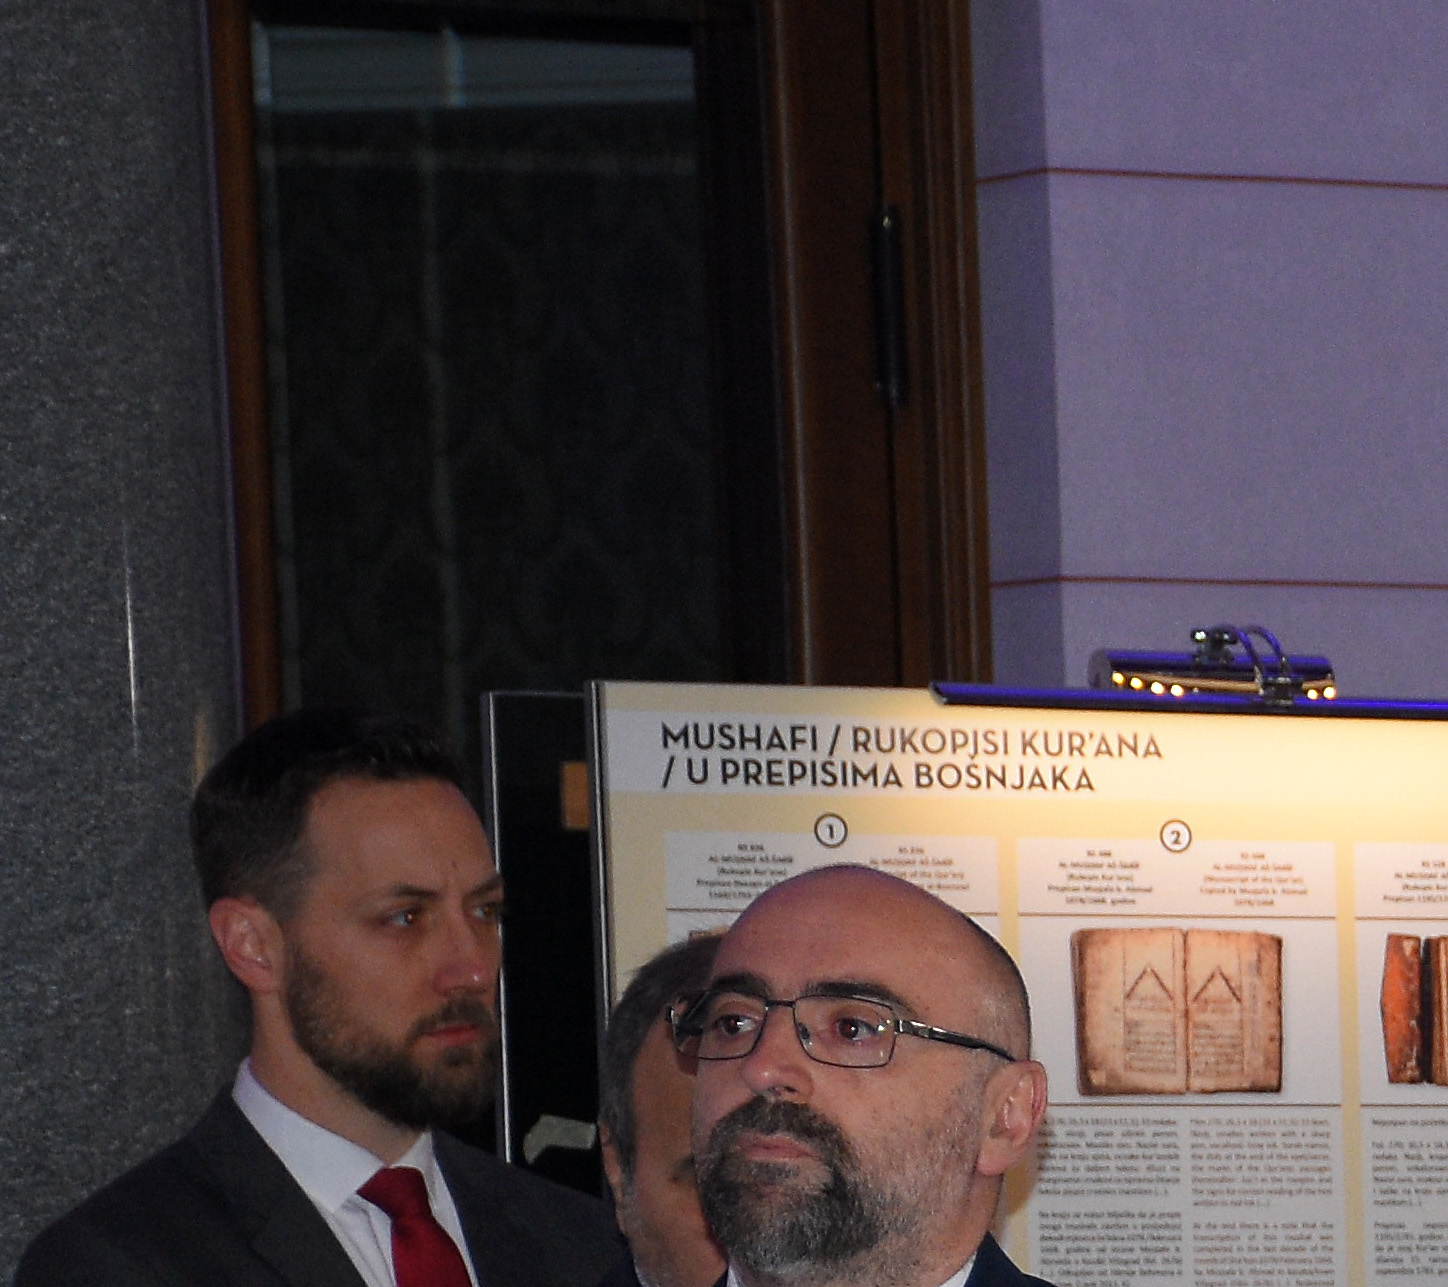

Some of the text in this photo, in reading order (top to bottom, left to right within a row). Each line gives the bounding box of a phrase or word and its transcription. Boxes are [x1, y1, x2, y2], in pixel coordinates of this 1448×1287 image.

[661, 722, 818, 751] MUSHAFI
[828, 723, 841, 757] /
[662, 755, 675, 788] /
[686, 758, 709, 785] U
[721, 758, 903, 788] PREPISIMA
[1170, 830, 1181, 845] 2
